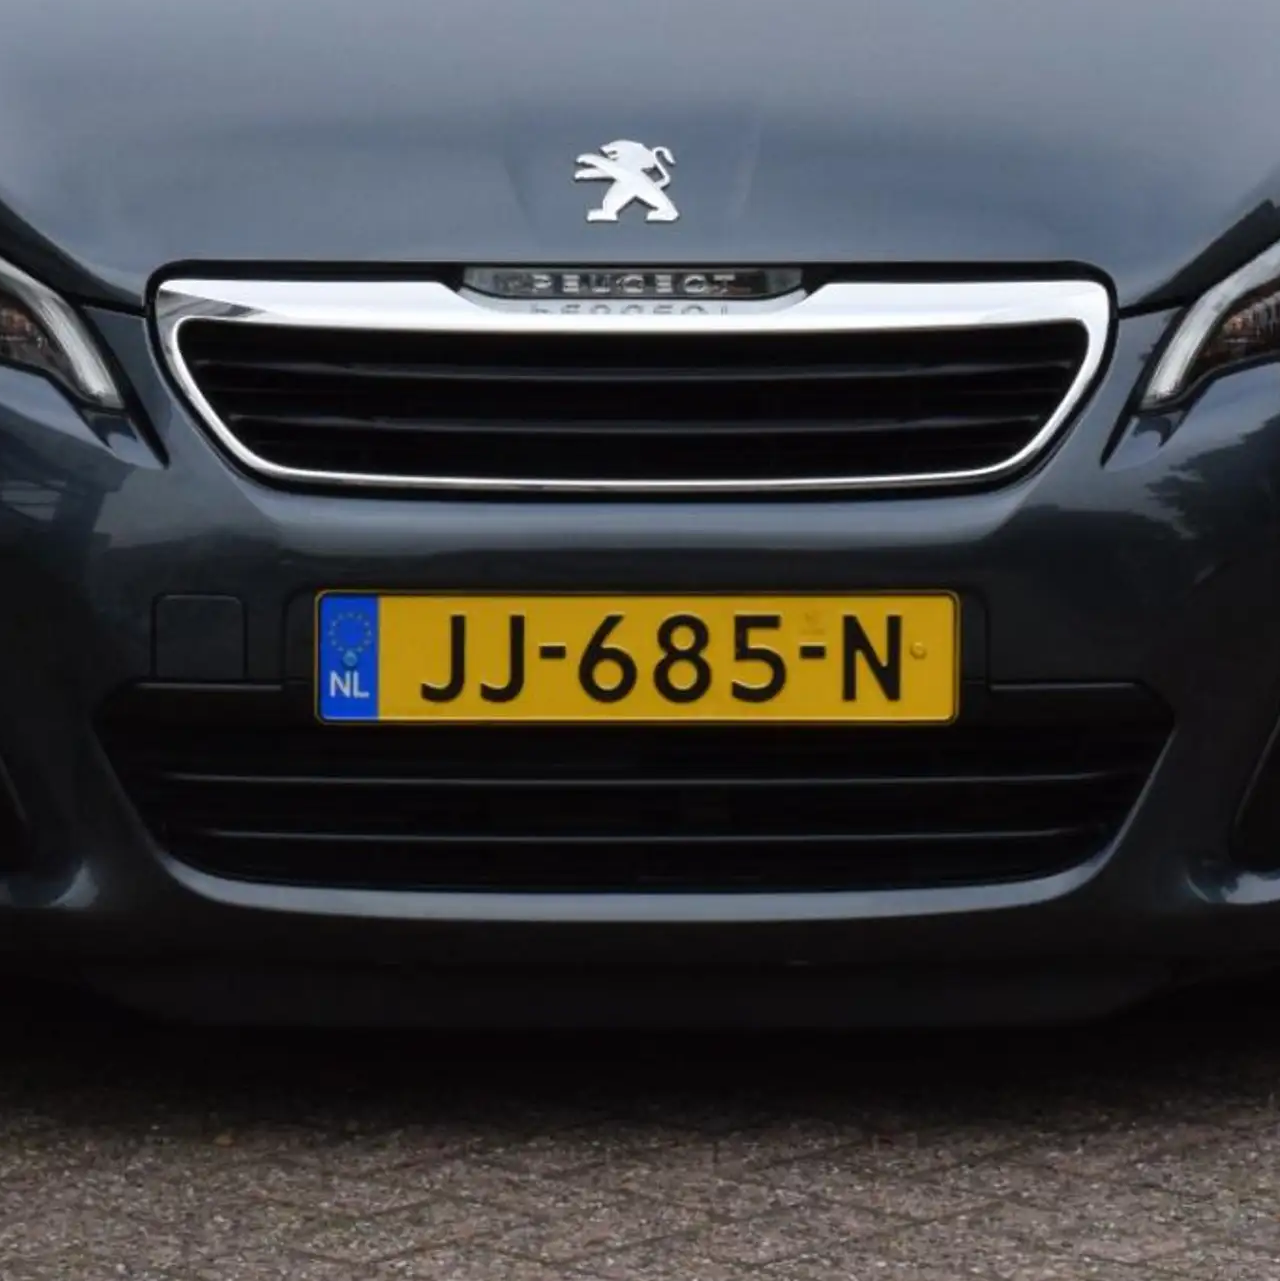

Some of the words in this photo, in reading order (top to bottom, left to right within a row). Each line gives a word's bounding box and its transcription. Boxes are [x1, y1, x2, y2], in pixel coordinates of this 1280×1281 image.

[531, 273, 737, 294] PEUGEOT
[329, 670, 370, 699] NL
[419, 613, 904, 704] JJ-685-N
